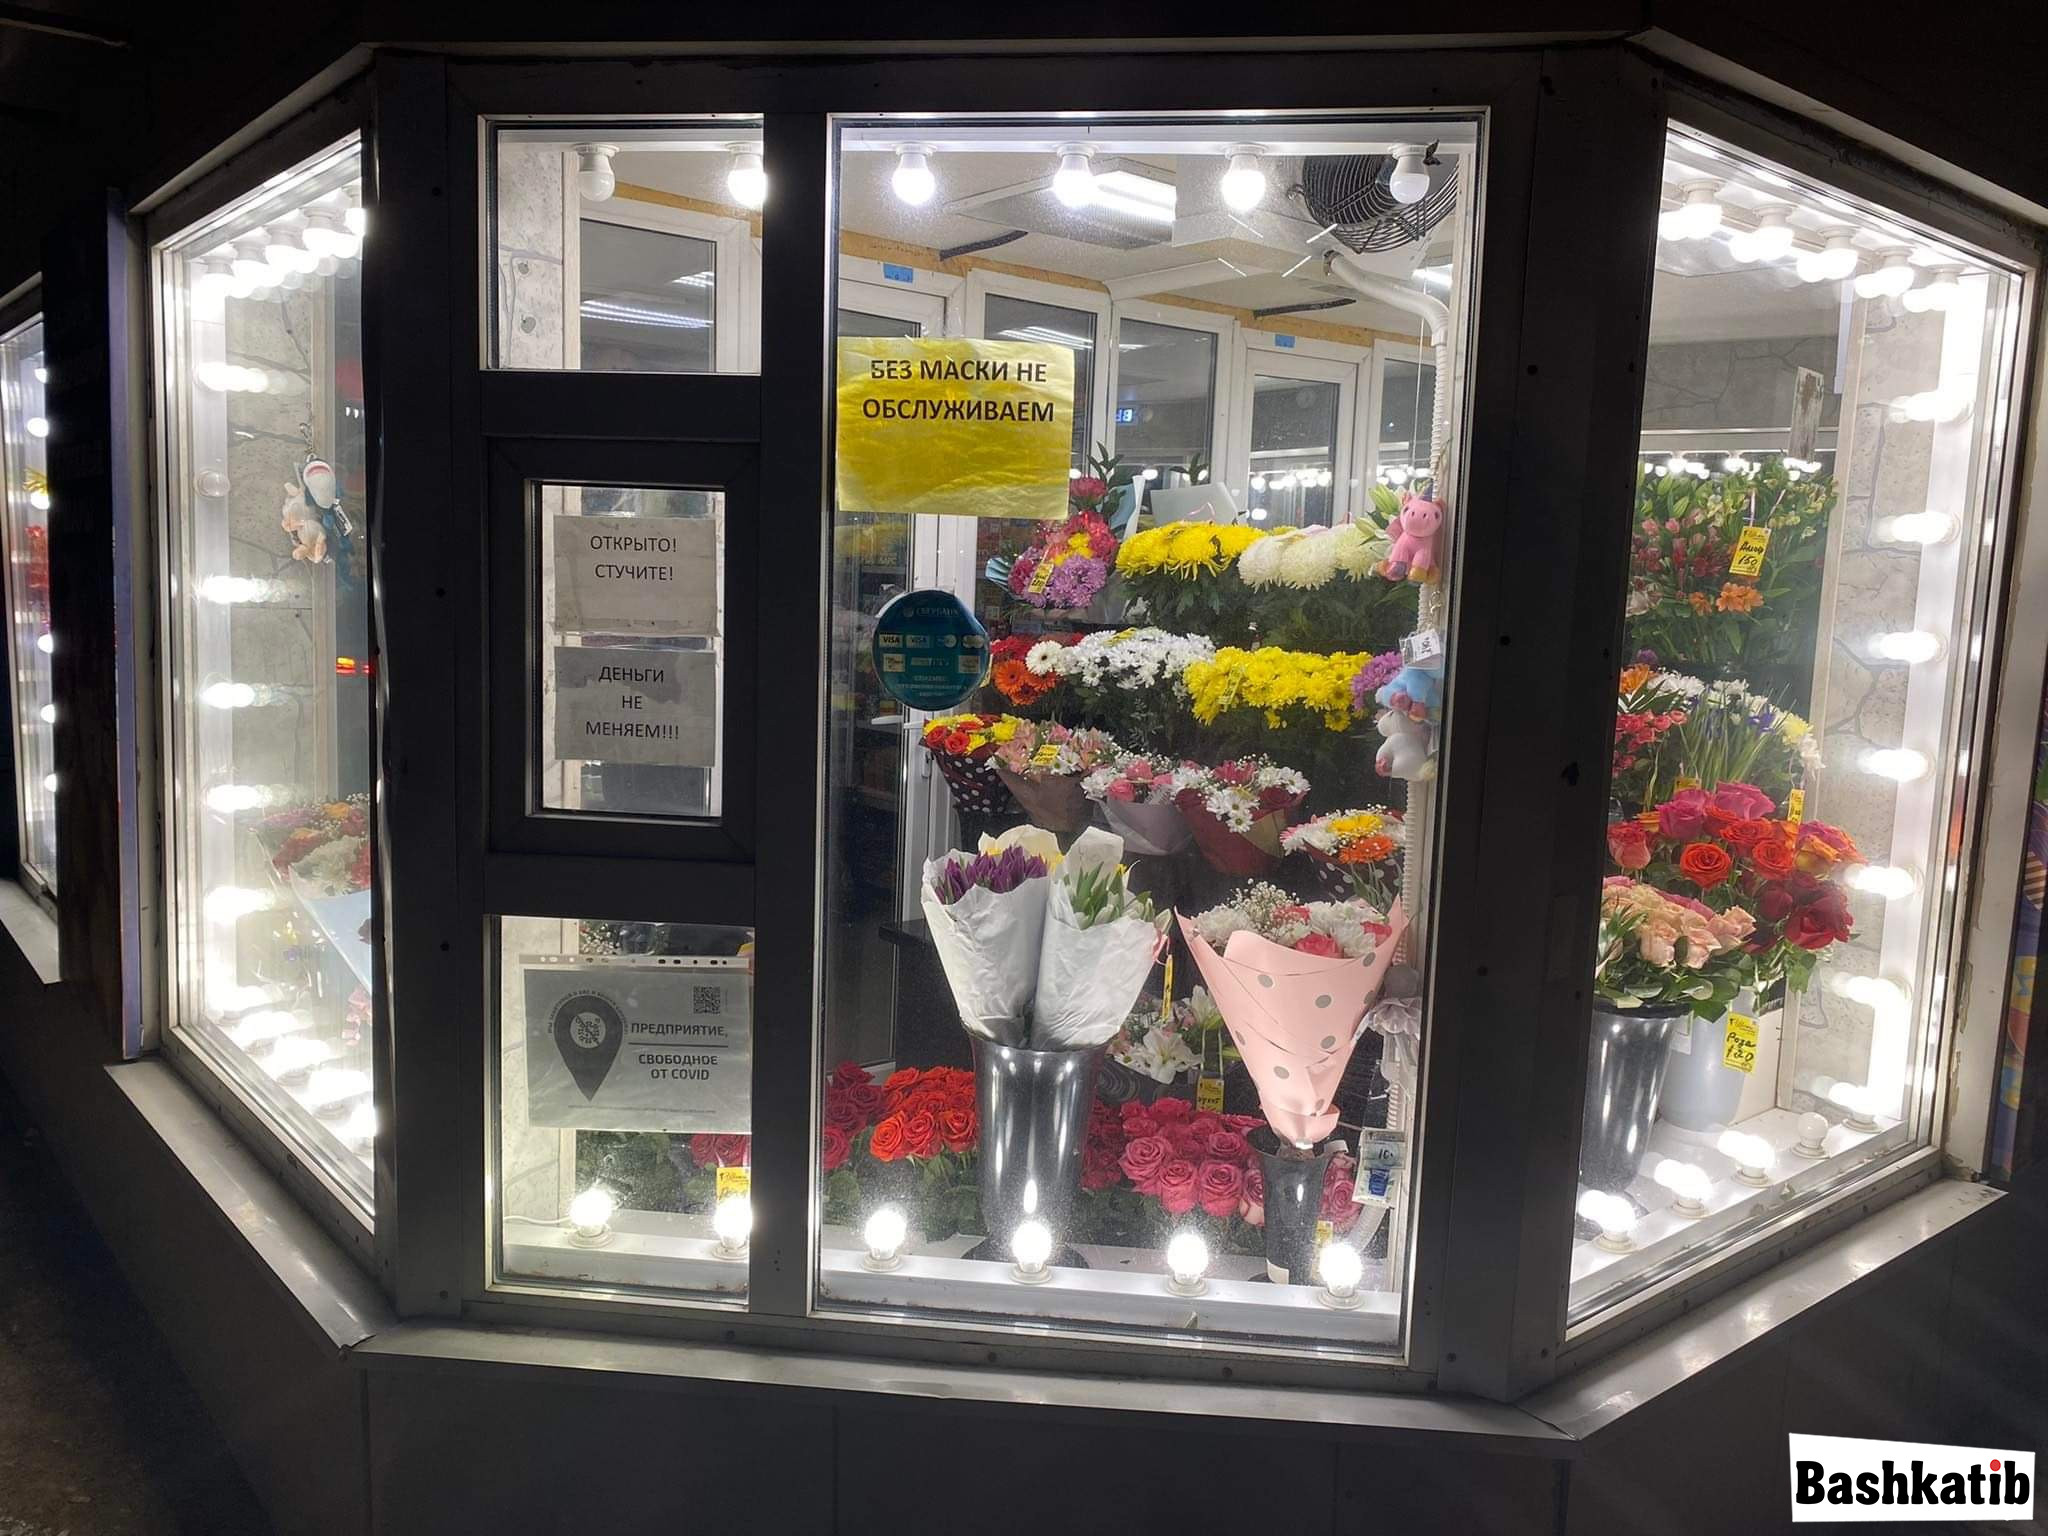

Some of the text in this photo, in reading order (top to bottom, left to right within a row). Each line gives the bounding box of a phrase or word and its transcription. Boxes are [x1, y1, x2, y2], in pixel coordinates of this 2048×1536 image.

[871, 359, 1047, 382] БЕЗ МАСКИ НЕ
[863, 399, 1054, 422] ОБСЛУЖИВАЕМ
[590, 535, 676, 552] ОТКРЫТО!
[1738, 555, 1758, 566] 150
[595, 564, 673, 581] СТУЧИТЕ!
[598, 666, 664, 683] ДЕНЬГИ
[622, 695, 643, 709] НЕ
[585, 721, 679, 739] МЕНЯЕМ!!!
[631, 1023, 728, 1037] ПРЕДПРИЯТИЕ,
[638, 1054, 718, 1066] СВОБОДНОЕ
[651, 1068, 710, 1080] ОТ COVID
